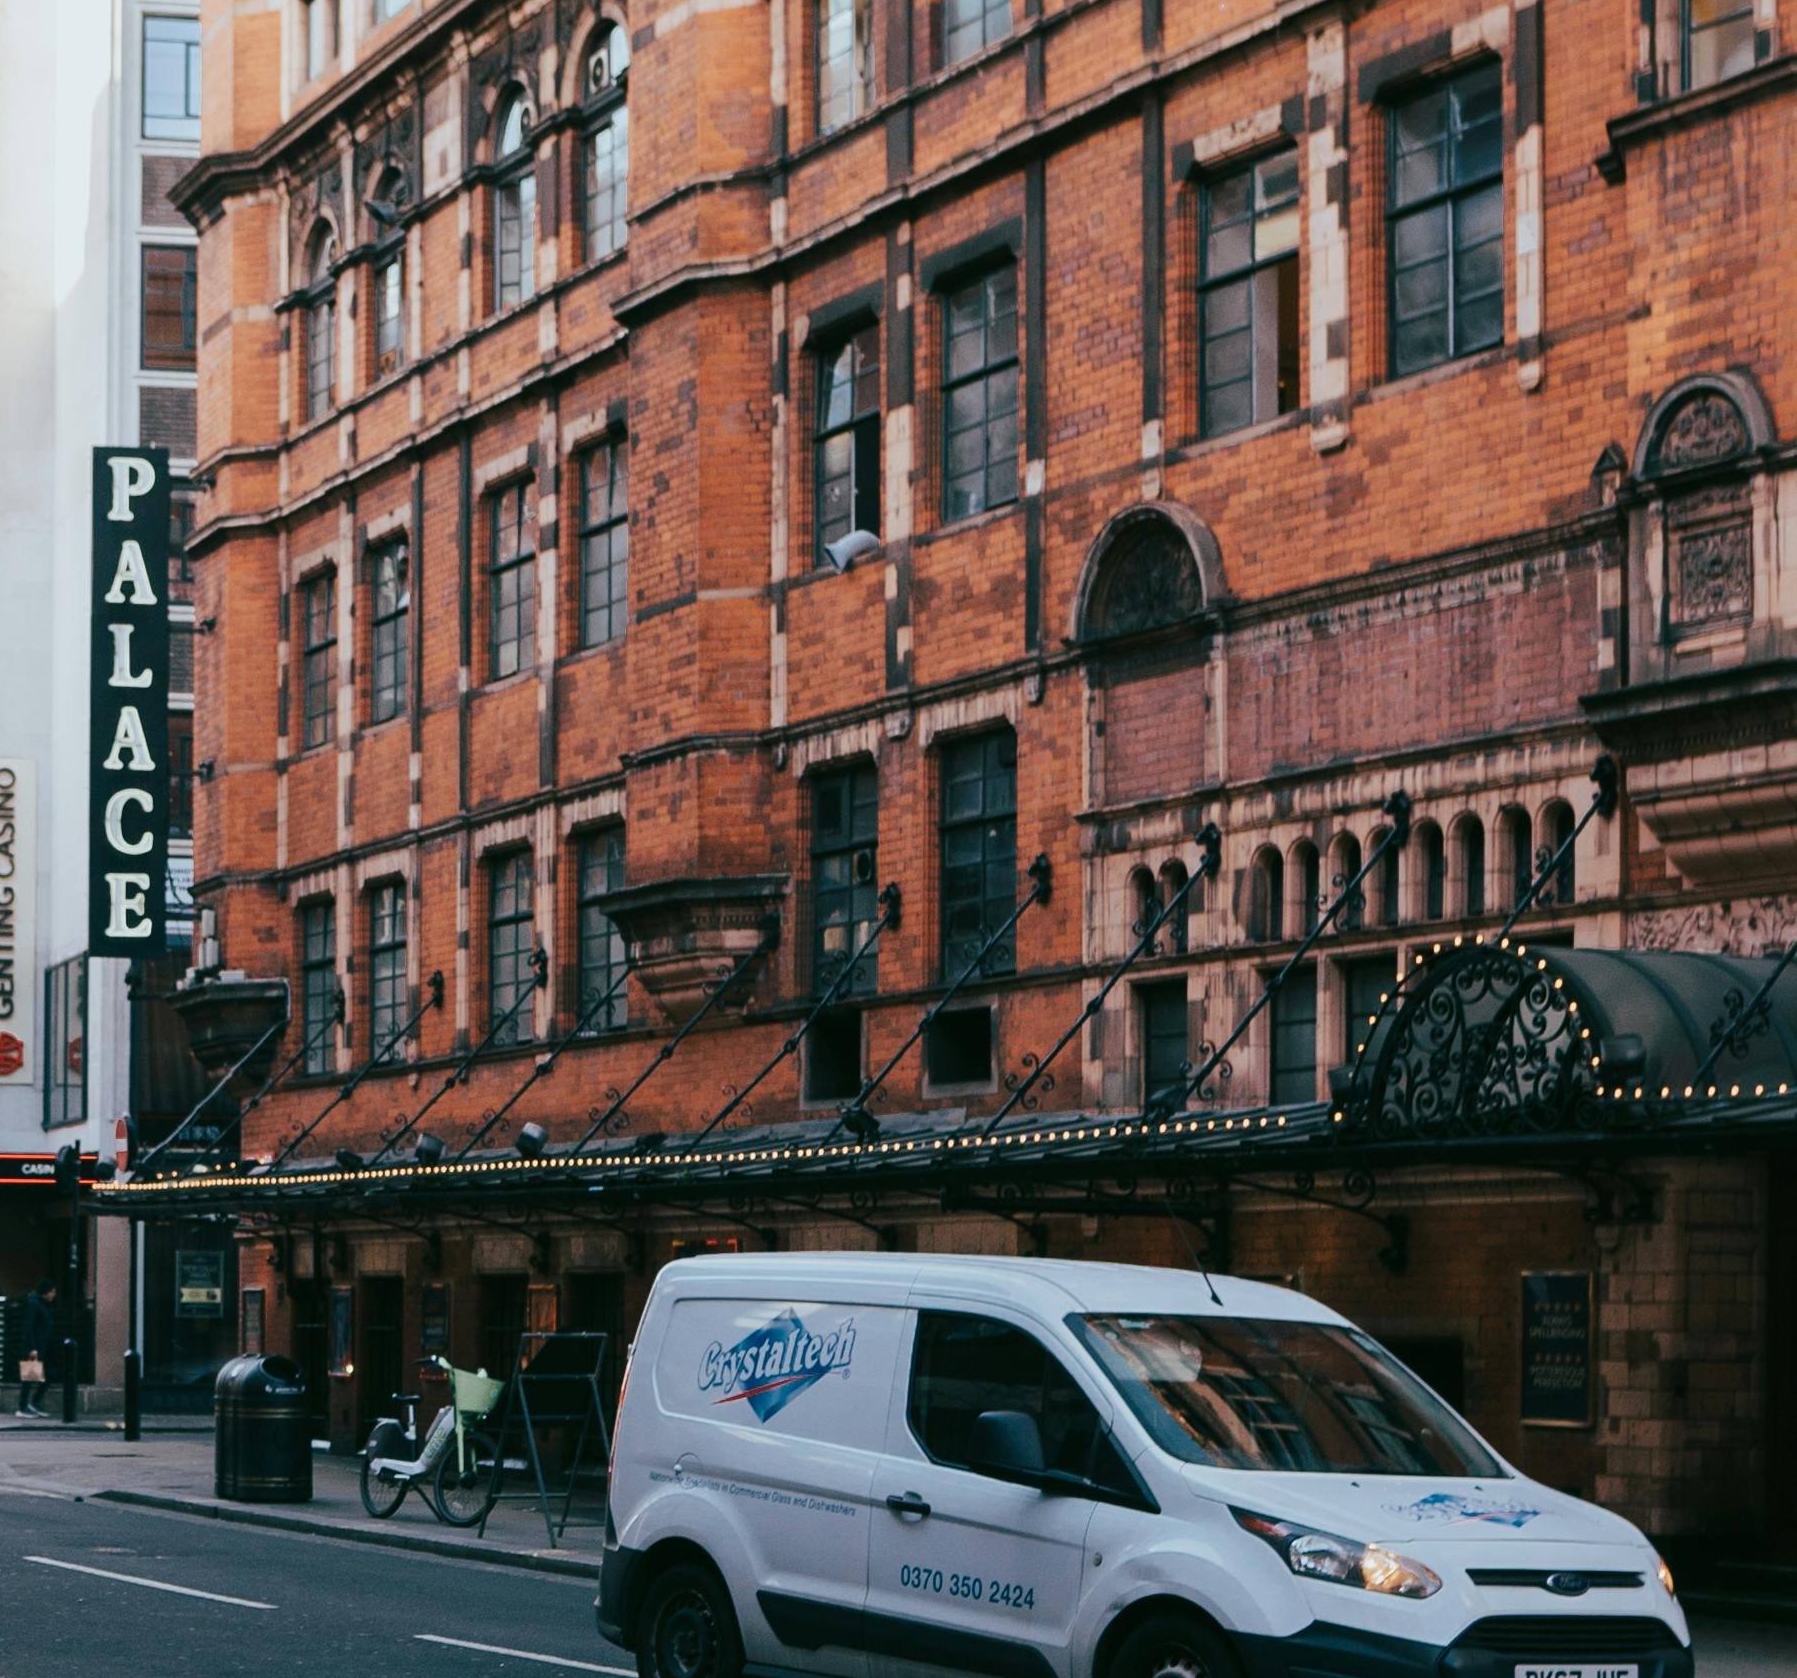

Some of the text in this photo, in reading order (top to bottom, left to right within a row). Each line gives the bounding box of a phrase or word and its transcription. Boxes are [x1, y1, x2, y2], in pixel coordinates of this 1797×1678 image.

[103, 456, 157, 938] PALACE
[697, 1316, 857, 1394] Crystaltech
[729, 1483, 771, 1501] Commercial
[771, 1490, 792, 1505] Glass
[793, 1497, 808, 1508] and
[808, 1498, 857, 1517] Dishwashers
[900, 1564, 1035, 1610] 0370 350 2424
